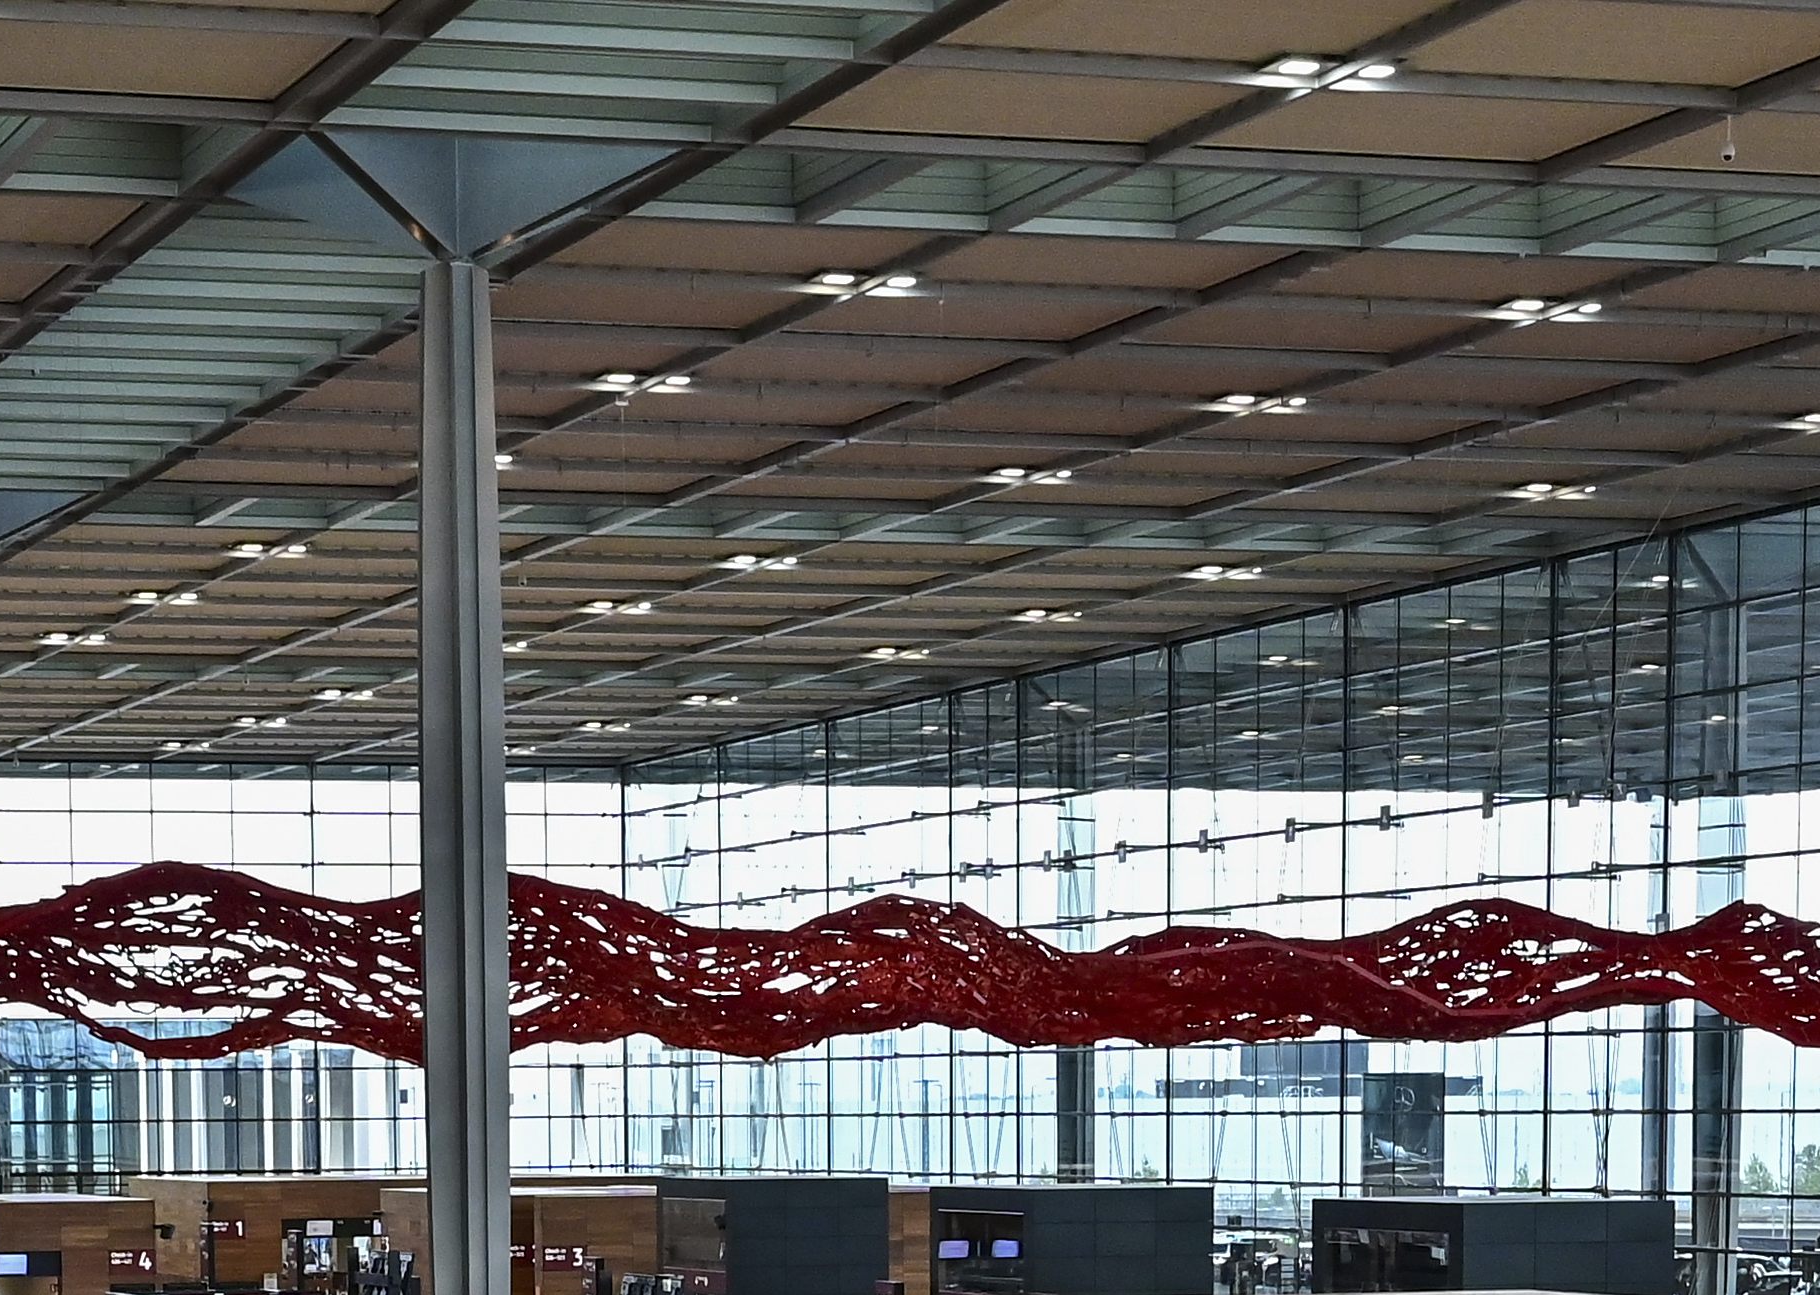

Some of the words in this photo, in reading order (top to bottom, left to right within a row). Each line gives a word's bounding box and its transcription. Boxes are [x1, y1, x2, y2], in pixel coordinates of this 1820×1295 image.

[235, 1220, 243, 1236] 1
[138, 1251, 152, 1270] 4
[572, 1248, 583, 1266] 3
